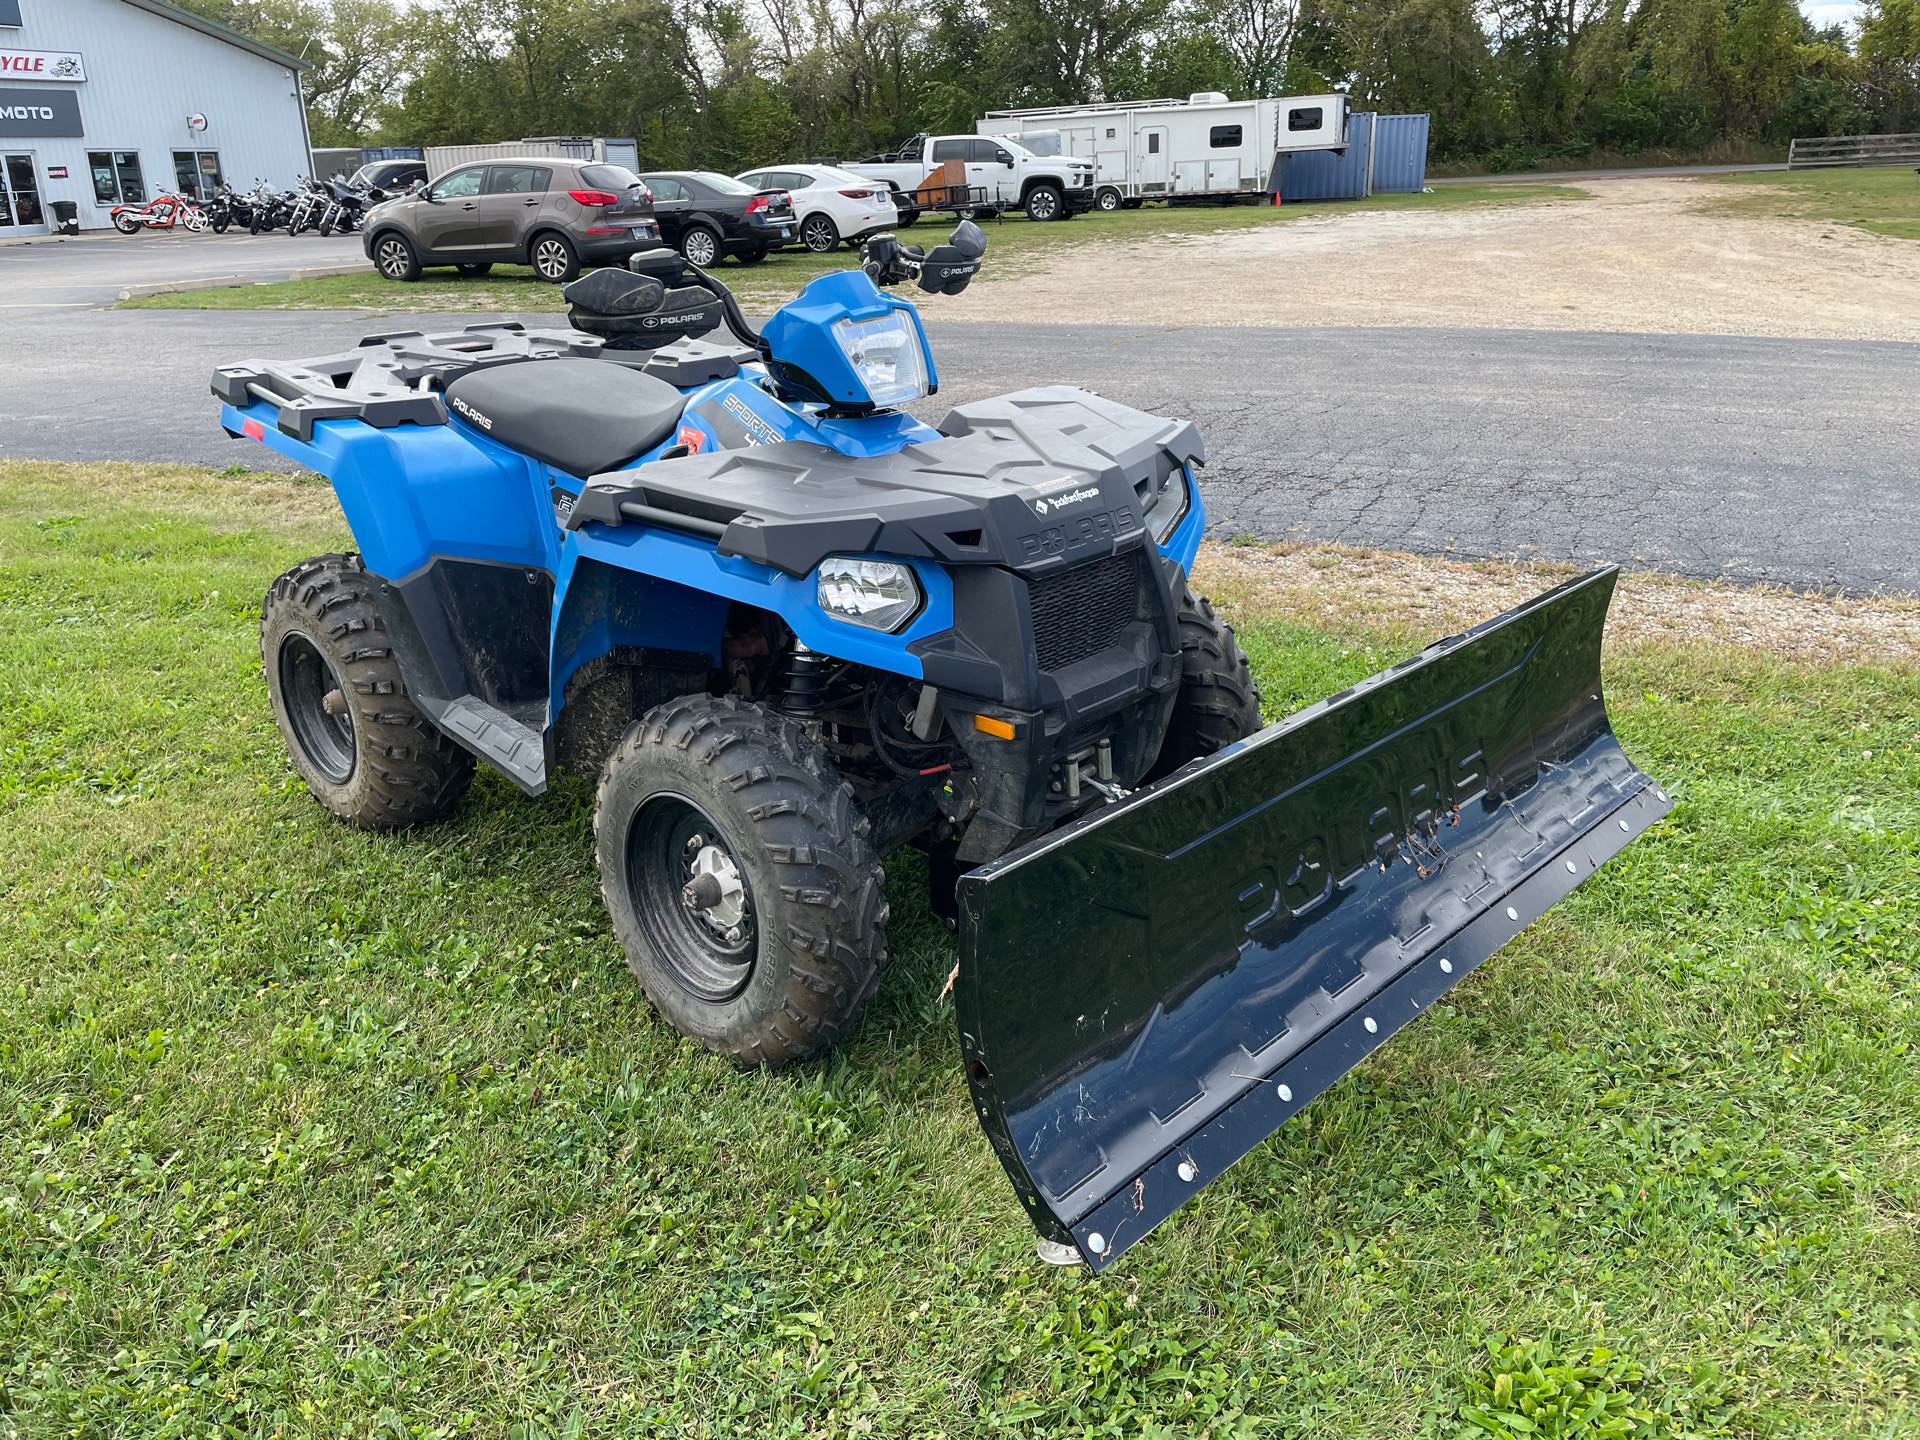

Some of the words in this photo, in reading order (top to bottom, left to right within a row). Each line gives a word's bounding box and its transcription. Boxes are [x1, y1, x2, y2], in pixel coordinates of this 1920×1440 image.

[0, 106, 53, 120] MOTO
[951, 265, 974, 275] POLARIS
[660, 312, 705, 325] POLARIS
[453, 396, 493, 430] POLARIS
[1016, 505, 1137, 563] POLARIS
[1228, 740, 1489, 952] POLARIS
